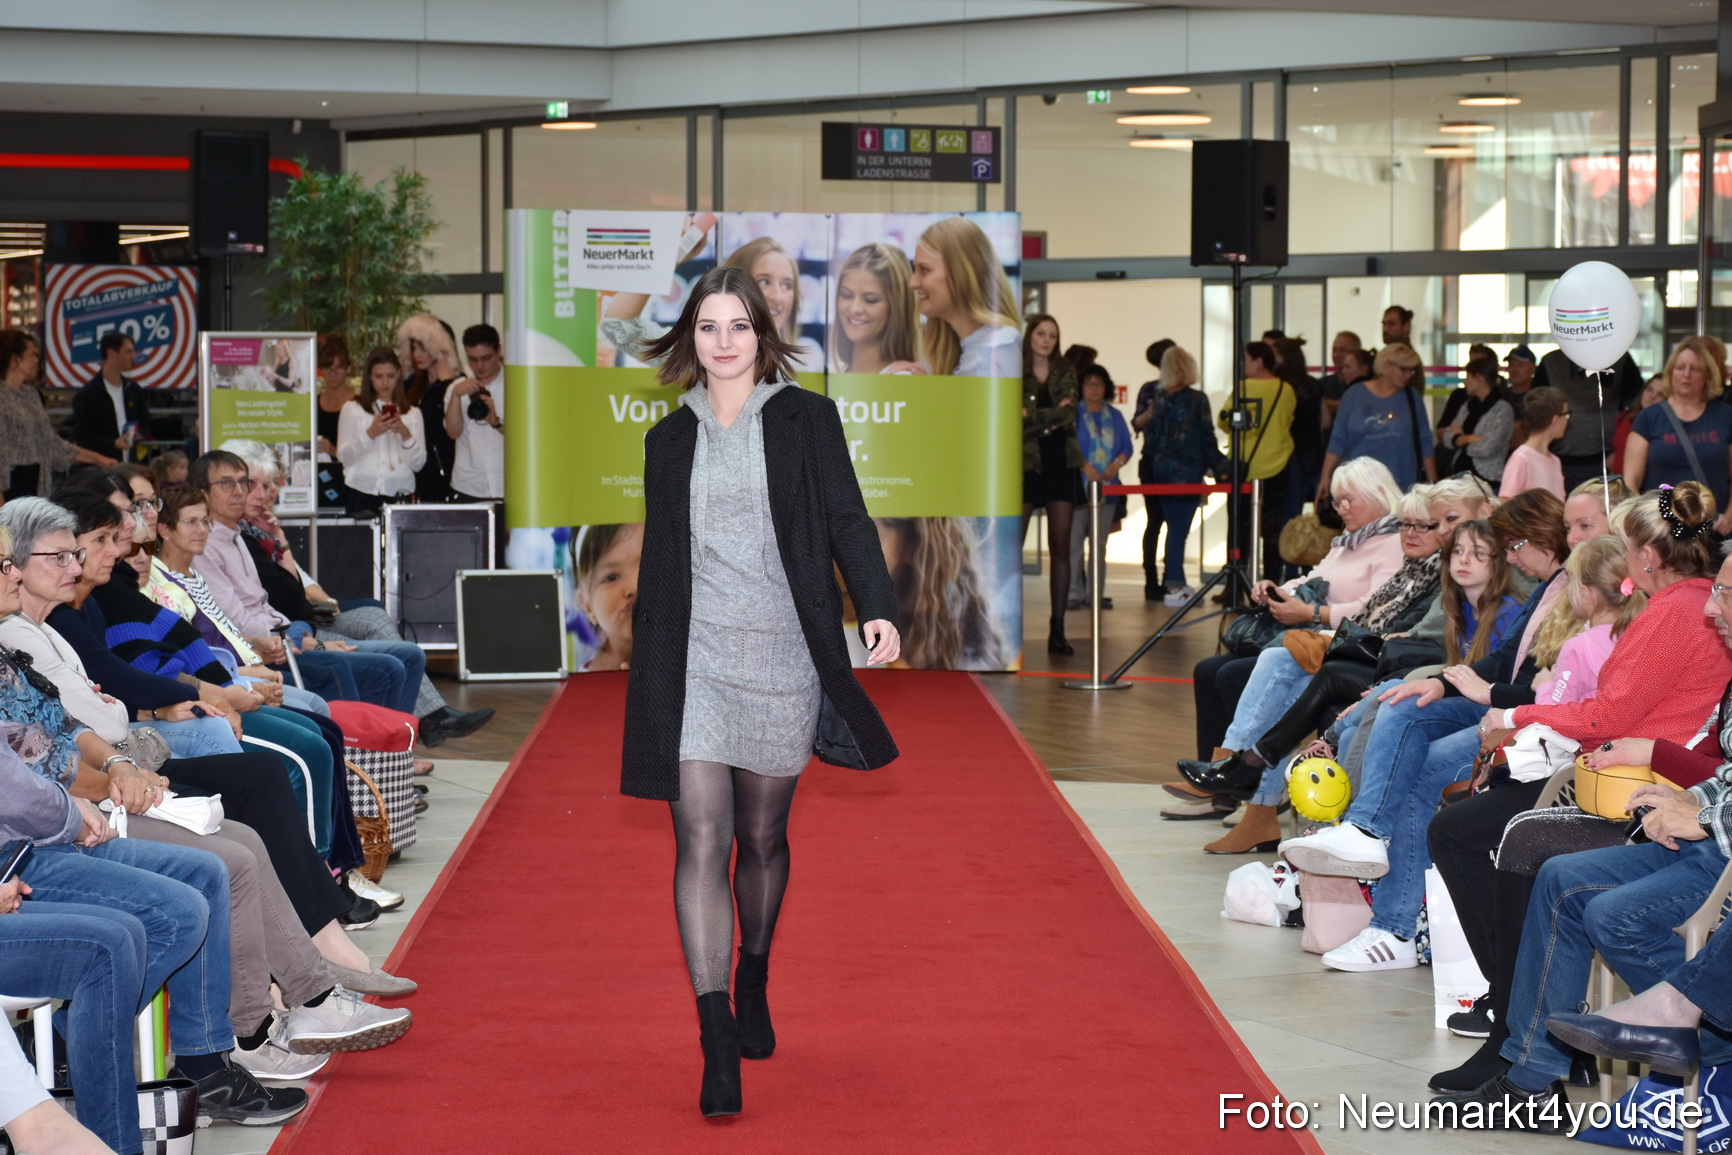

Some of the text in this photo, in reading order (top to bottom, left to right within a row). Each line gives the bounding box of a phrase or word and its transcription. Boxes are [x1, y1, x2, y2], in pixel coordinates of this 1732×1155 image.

[857, 155, 932, 167] IN DER UNTEREN
[856, 167, 931, 179] LADENSTRASSE
[583, 248, 654, 260] NeuerMarkt
[1553, 321, 1614, 335] NeuerMarkt
[608, 394, 669, 423] Von
[613, 475, 645, 486] Stadtq
[858, 475, 914, 486] astronomie,
